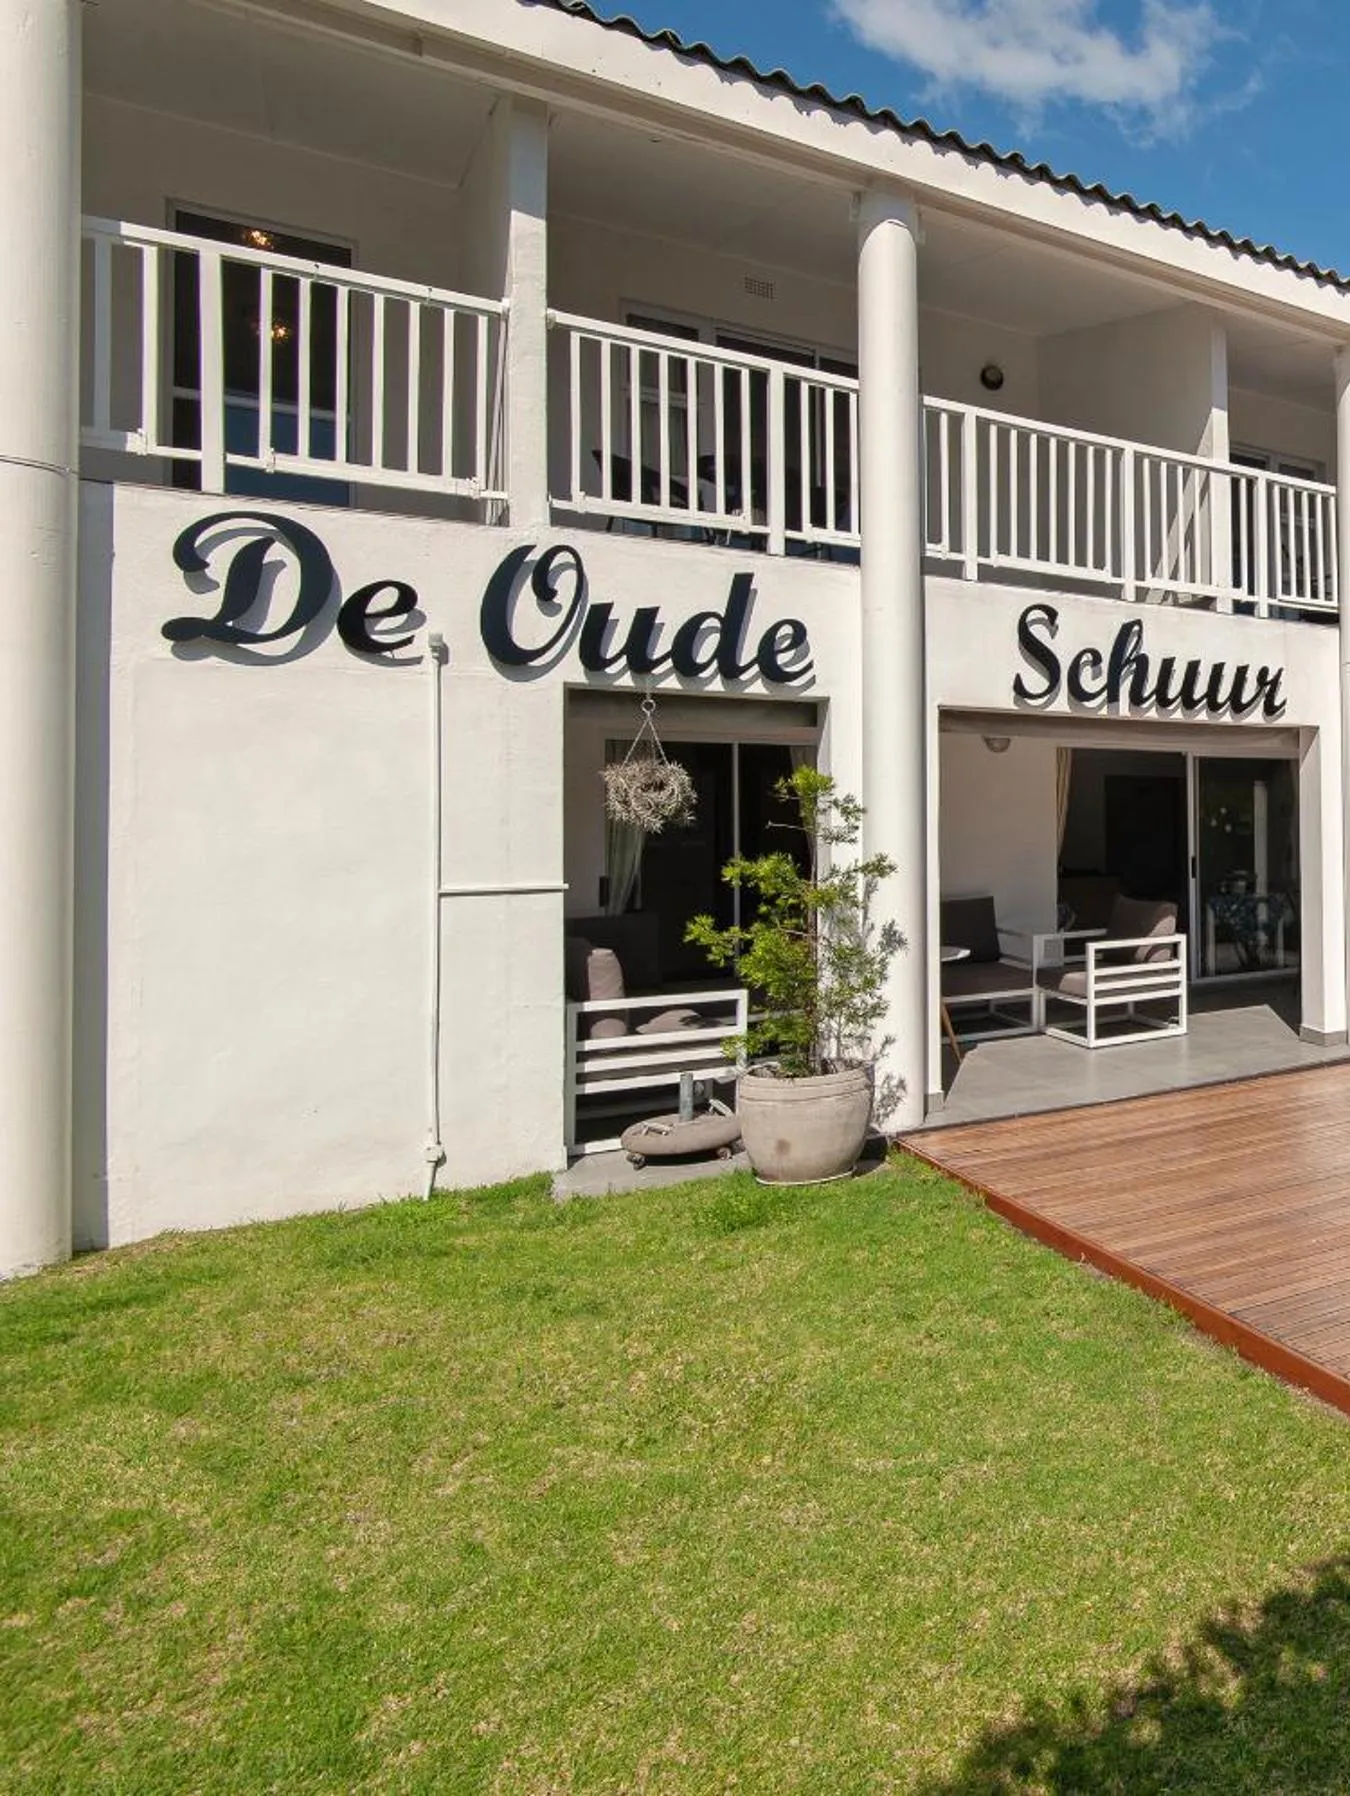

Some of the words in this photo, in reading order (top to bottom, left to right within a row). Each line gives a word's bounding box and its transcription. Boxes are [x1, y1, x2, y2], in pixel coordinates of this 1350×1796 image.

[161, 511, 419, 654] De
[480, 545, 815, 684] Oude
[1013, 603, 1288, 716] Schuur
